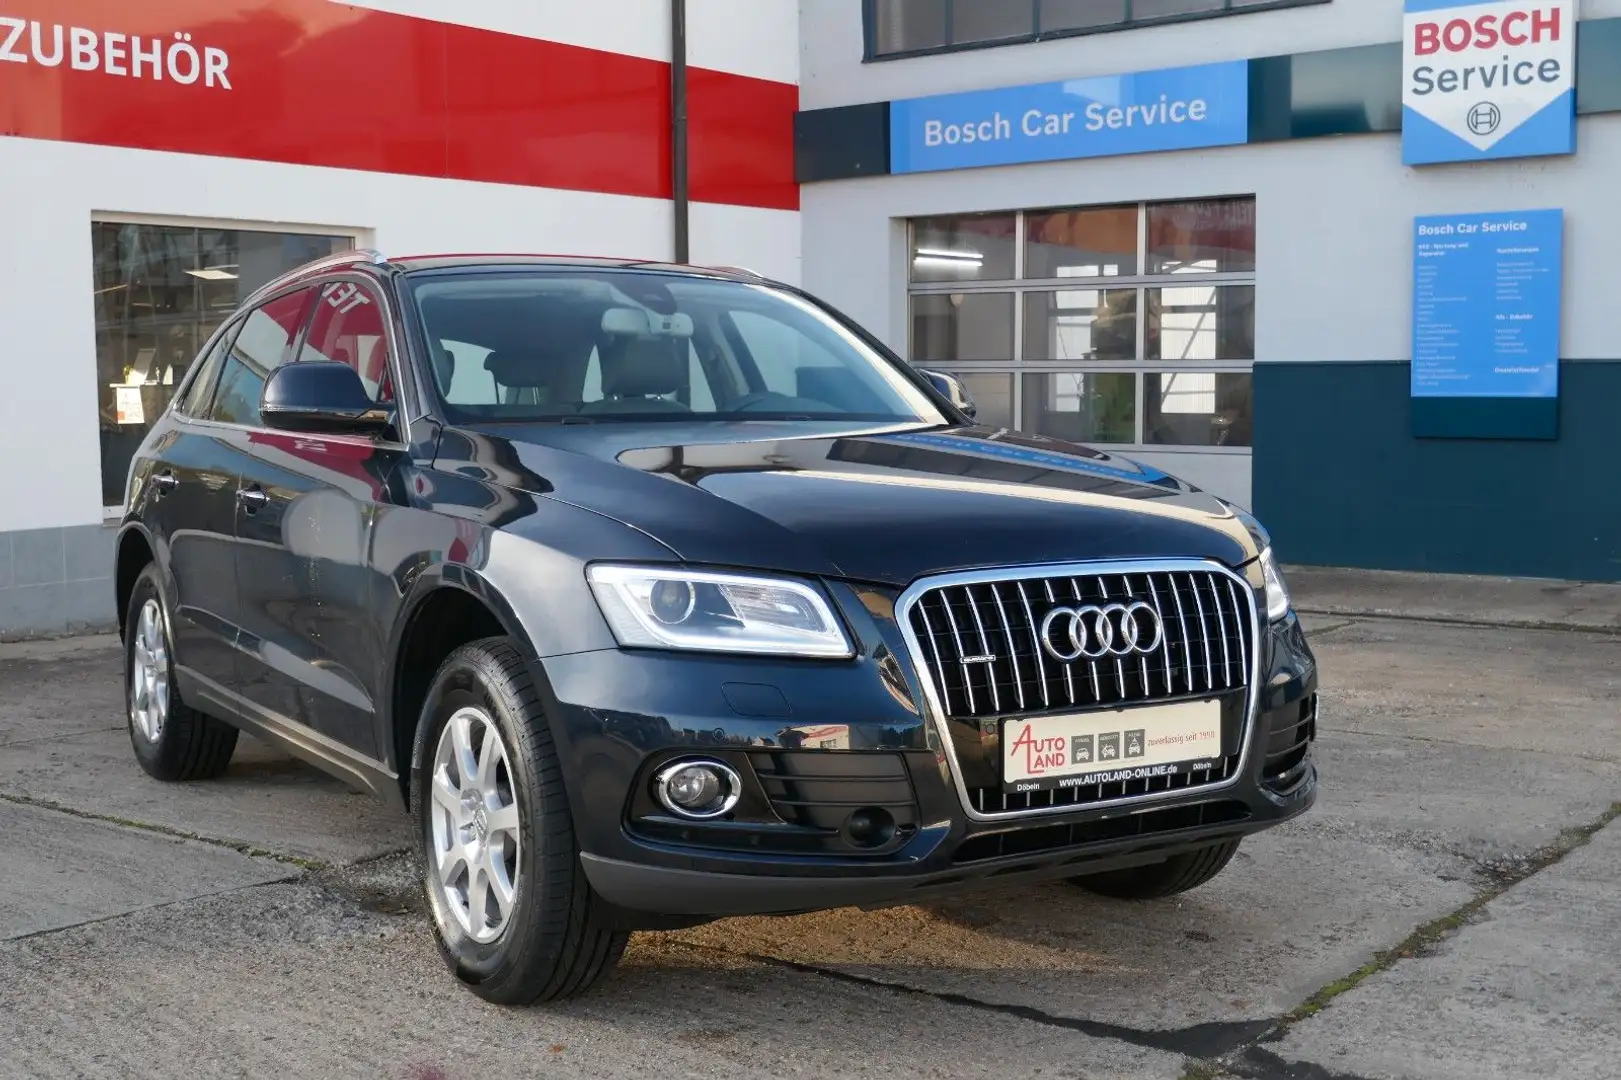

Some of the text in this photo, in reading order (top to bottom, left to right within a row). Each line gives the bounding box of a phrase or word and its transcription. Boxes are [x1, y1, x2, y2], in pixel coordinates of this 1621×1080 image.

[1414, 7, 1561, 56] BOSCH
[0, 16, 232, 91] ZUBEHÖR
[1411, 54, 1561, 96] Service
[924, 94, 1208, 147] Bosch Car Service
[1418, 220, 1527, 236] Bosch Car Service
[1010, 723, 1066, 757] AUTO
[1026, 751, 1066, 775] LAND
[1059, 765, 1178, 788] www.AUTOLAND-ONLINE.de
